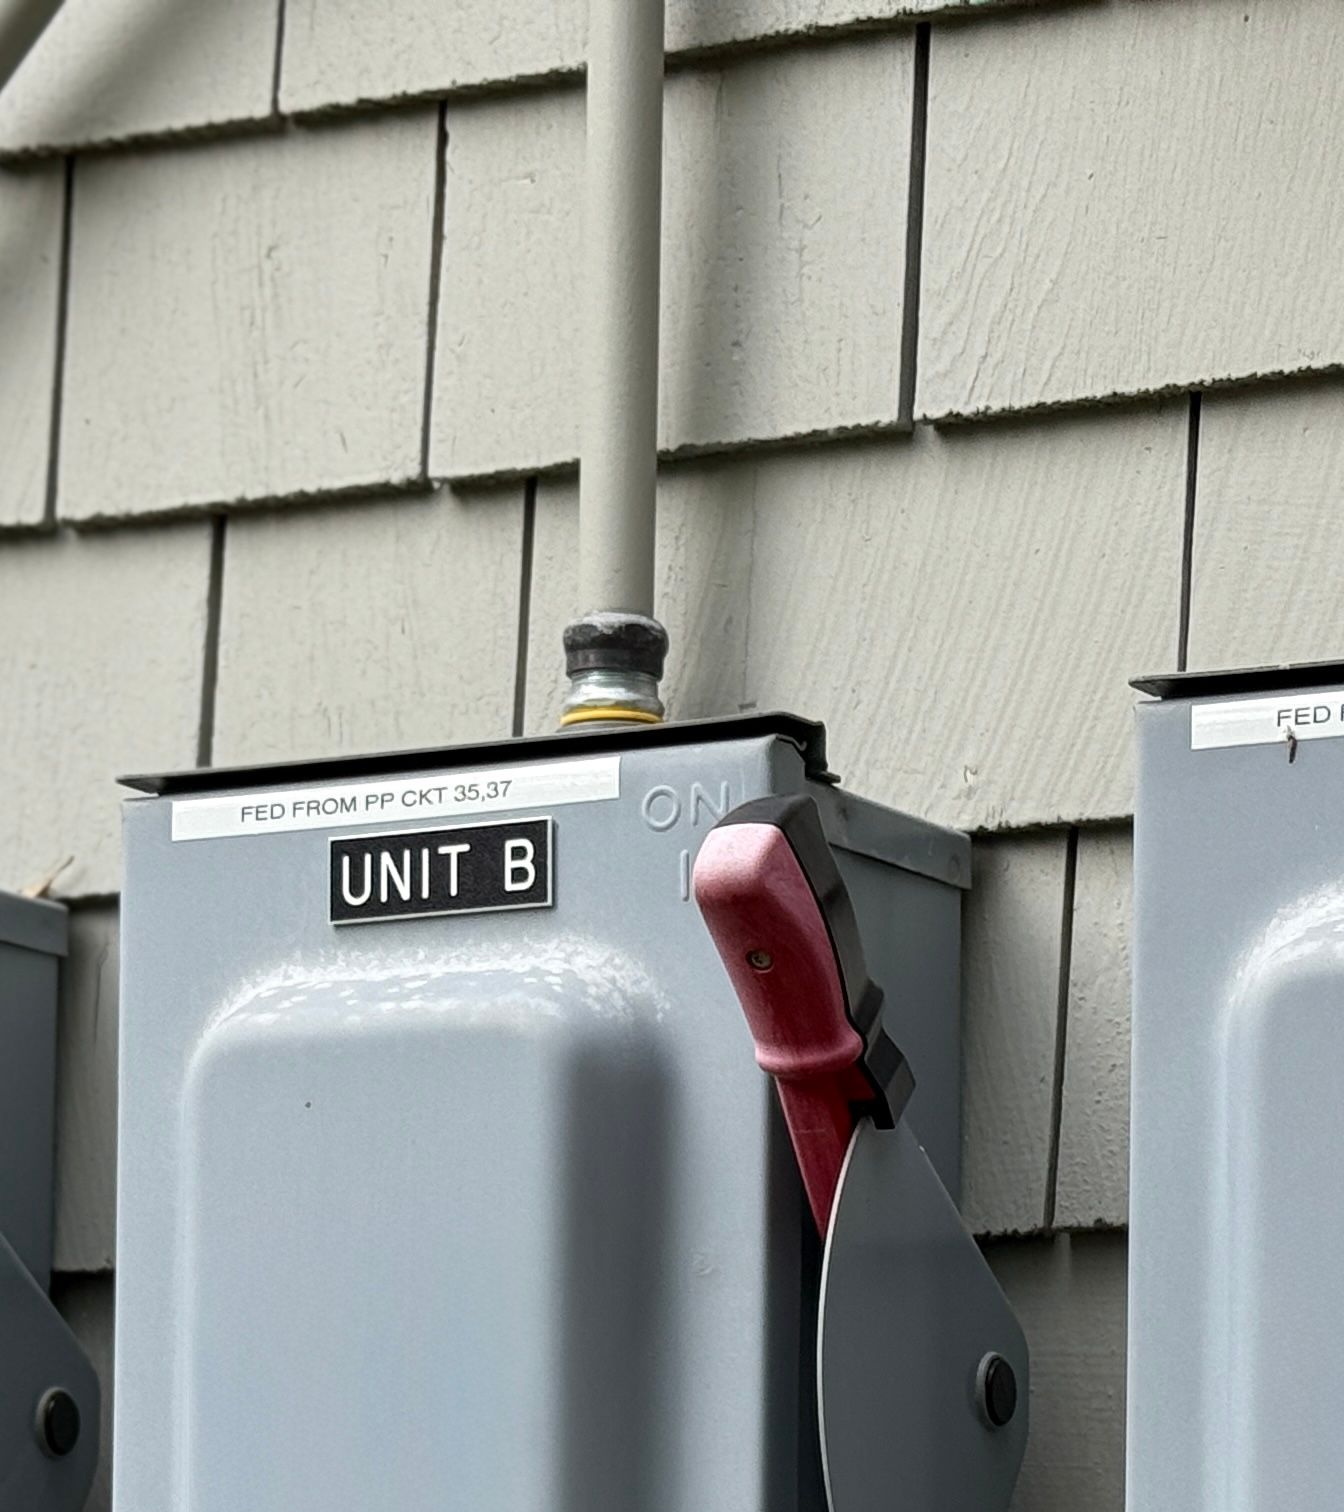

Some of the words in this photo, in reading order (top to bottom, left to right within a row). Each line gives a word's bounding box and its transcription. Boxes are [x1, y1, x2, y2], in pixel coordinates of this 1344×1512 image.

[1277, 706, 1332, 728] FED
[241, 804, 285, 823] FED
[292, 795, 357, 818] FROM
[365, 792, 395, 811] PP
[401, 787, 448, 808] CKT
[454, 779, 513, 802] 35,37
[642, 781, 729, 832] ON
[342, 843, 471, 906] UNIT
[505, 838, 536, 892] B
